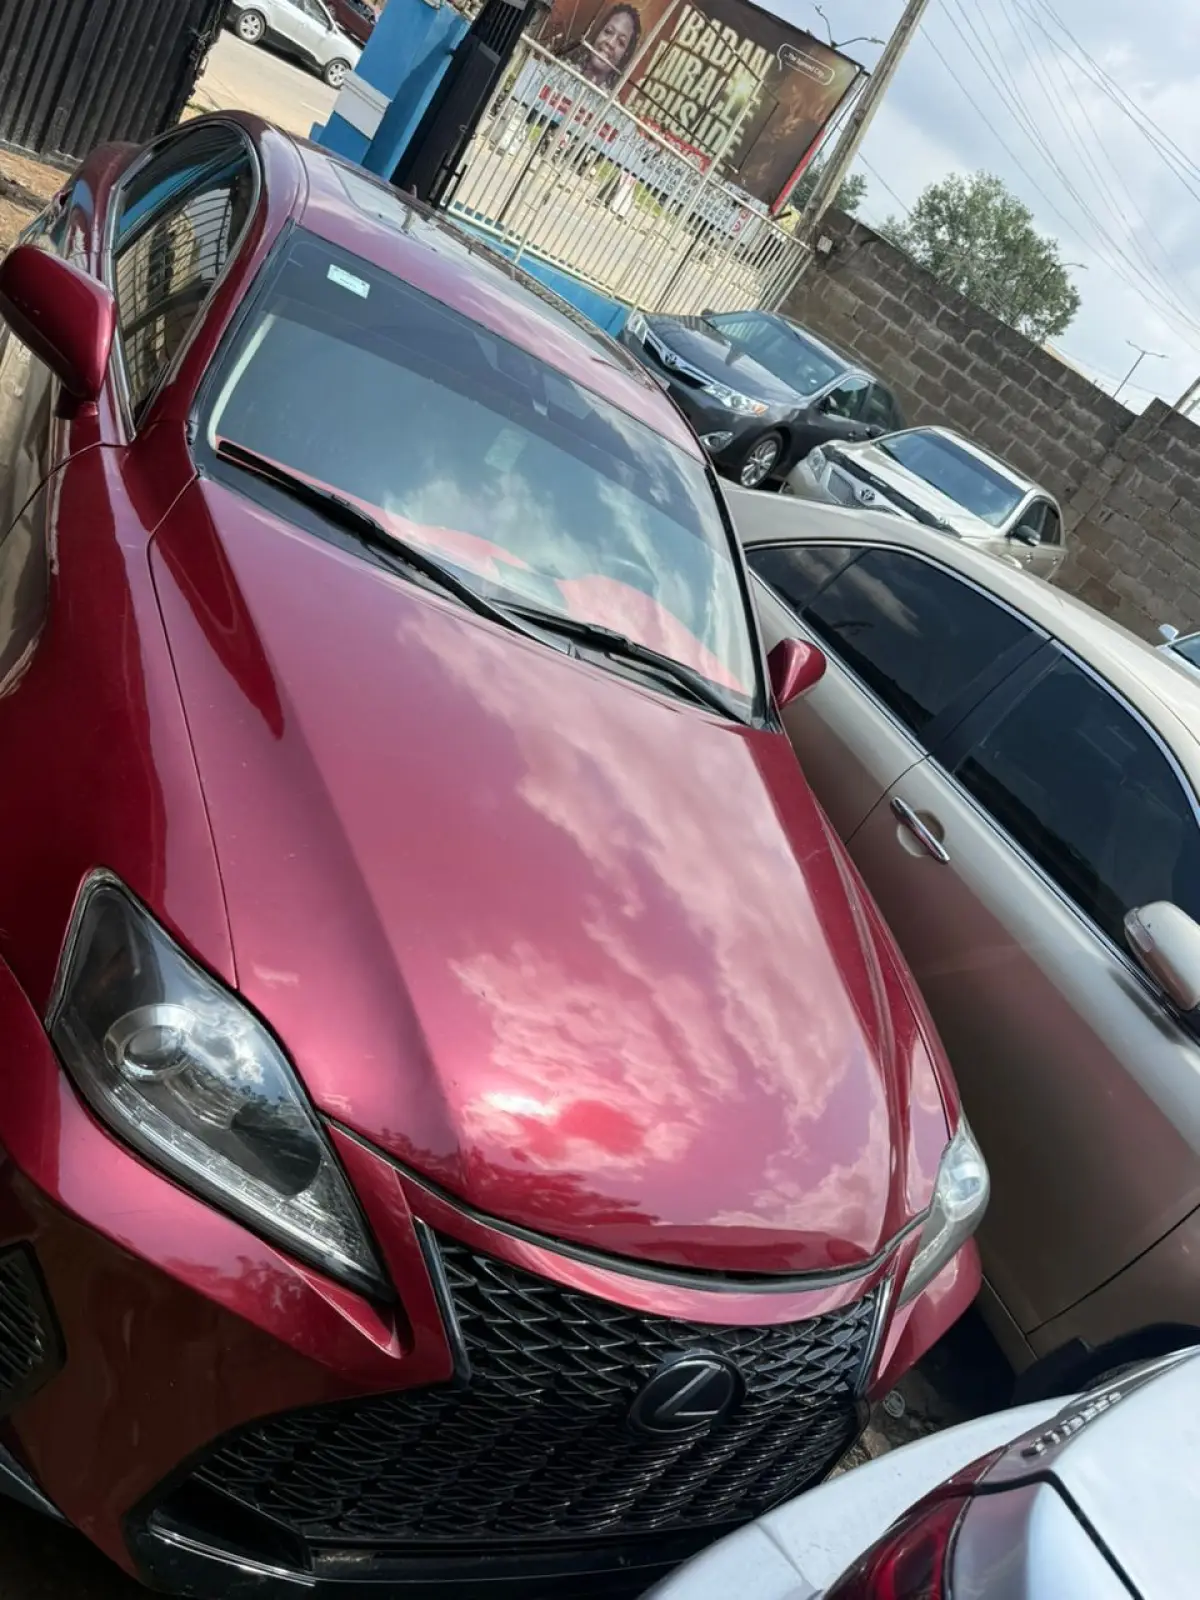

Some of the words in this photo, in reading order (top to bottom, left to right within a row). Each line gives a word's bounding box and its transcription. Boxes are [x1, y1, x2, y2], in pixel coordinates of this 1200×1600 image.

[644, 40, 762, 135] MIRACLE
[670, 4, 775, 95] IBADAN
[623, 77, 744, 173] CRUSADE
